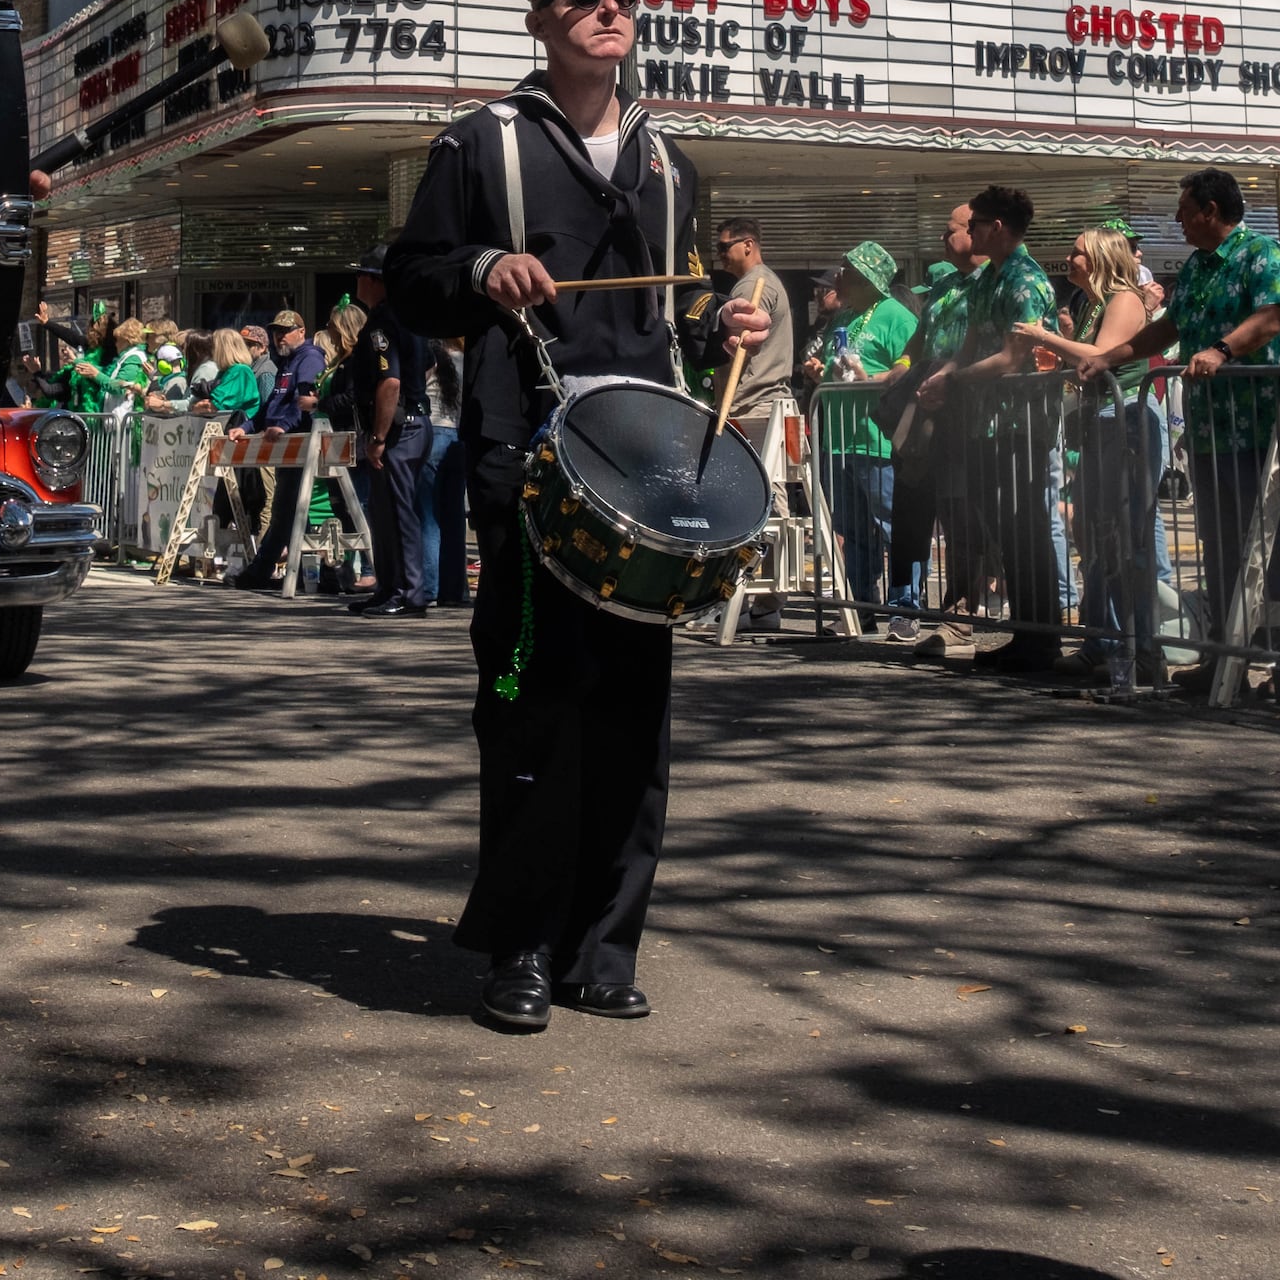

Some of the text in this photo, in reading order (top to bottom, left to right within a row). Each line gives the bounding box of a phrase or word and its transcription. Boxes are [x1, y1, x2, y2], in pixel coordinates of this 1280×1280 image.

[264, 22, 315, 59] 233
[340, 18, 446, 56] 7764
[765, 22, 807, 58] OF
[1066, 5, 1224, 51] GHOSTED
[975, 41, 1087, 81] IMPROV
[1107, 51, 1224, 89] COMEDY
[639, 59, 864, 108] NKIE VALLI
[209, 280, 289, 290] NOW SHOWING
[164, 424, 183, 446] of
[154, 450, 194, 469] welcom
[671, 519, 710, 529] EVANS
